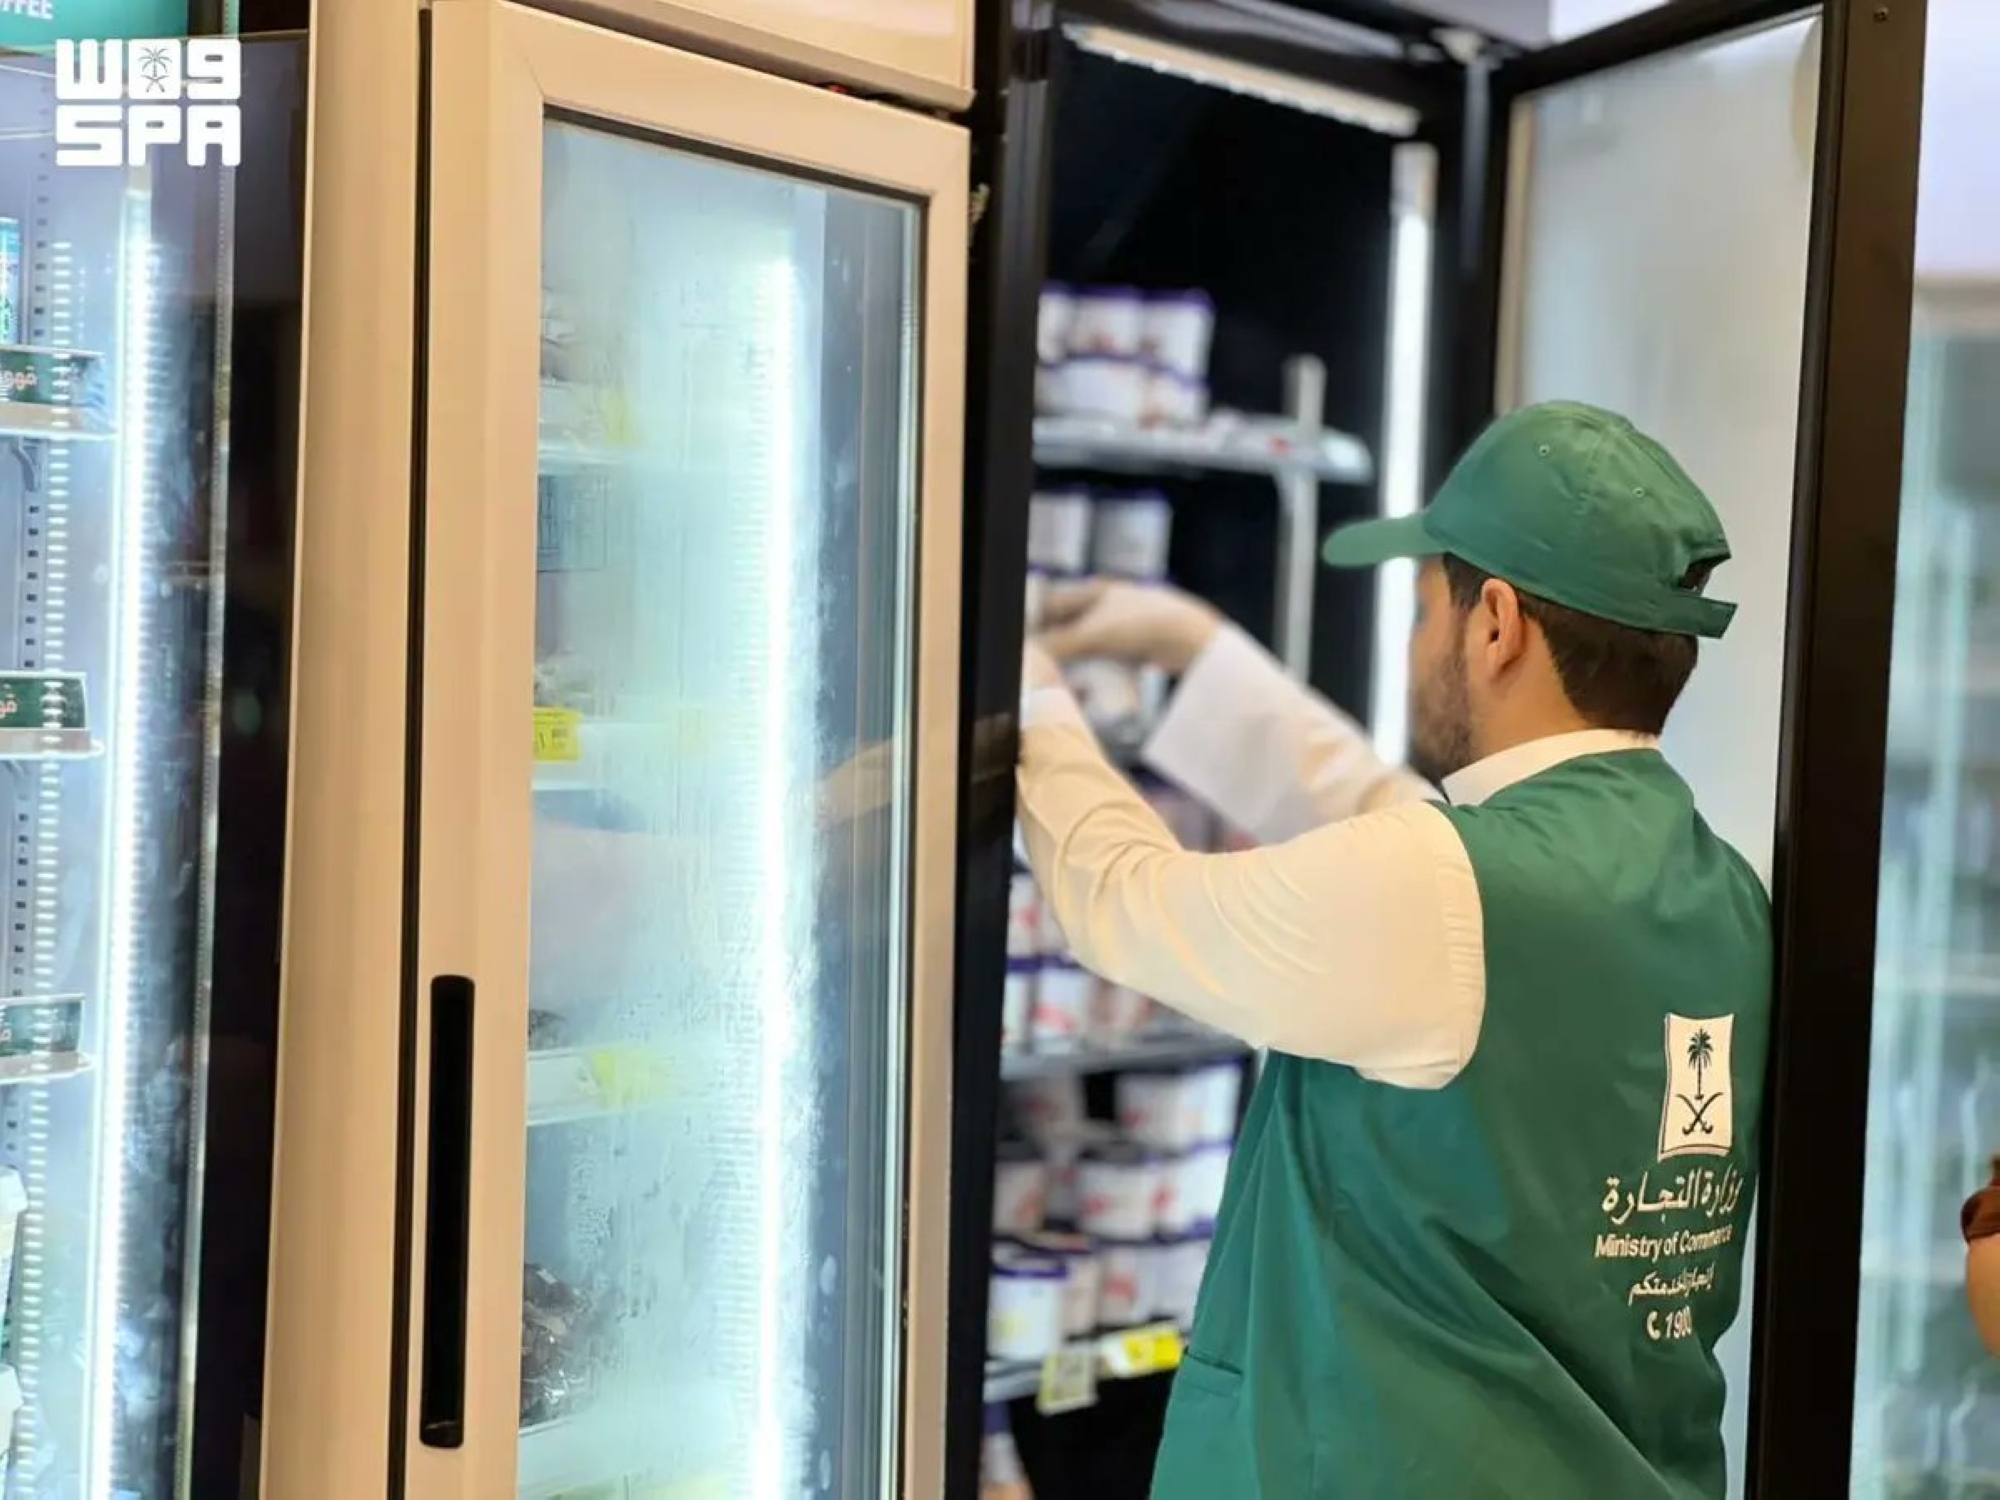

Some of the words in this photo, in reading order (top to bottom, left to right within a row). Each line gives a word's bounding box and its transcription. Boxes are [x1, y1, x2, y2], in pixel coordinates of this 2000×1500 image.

[1601, 1167, 1702, 1225] التجارة
[1701, 1163, 1744, 1218] وزارة
[1595, 1233, 1661, 1263] Ministry
[1663, 1231, 1680, 1256] of
